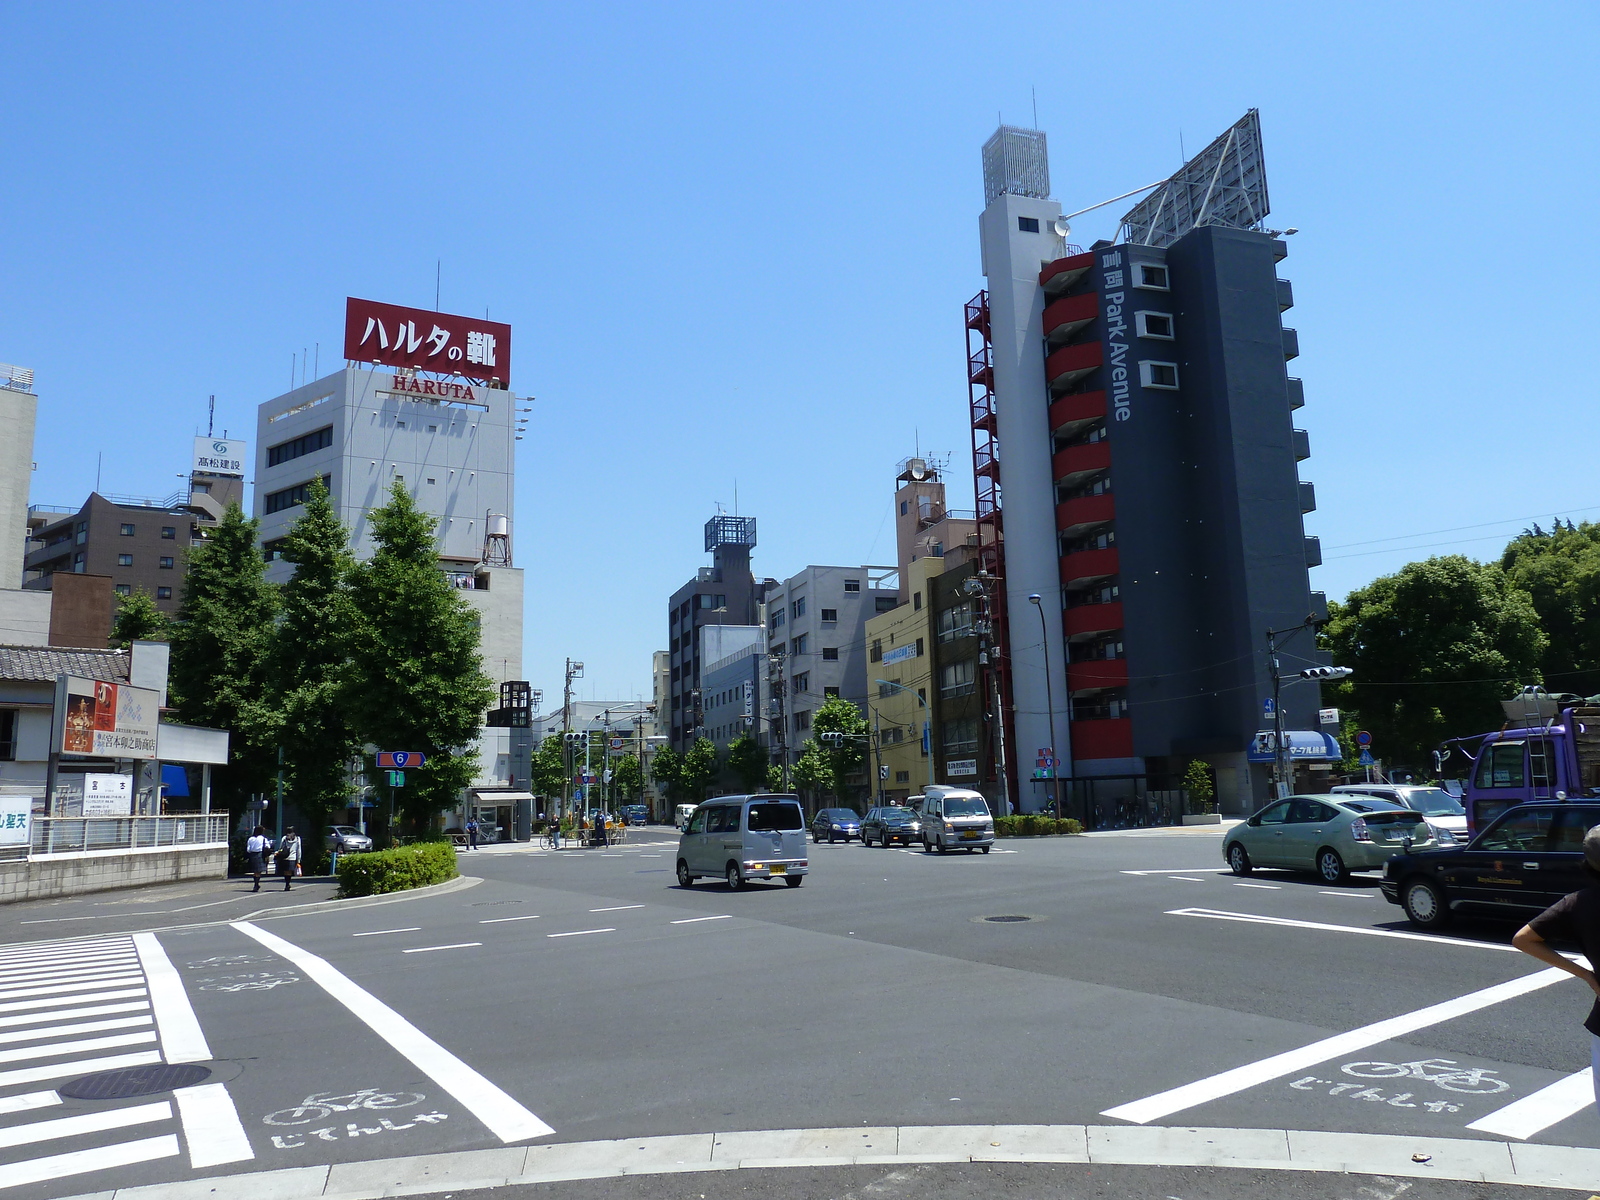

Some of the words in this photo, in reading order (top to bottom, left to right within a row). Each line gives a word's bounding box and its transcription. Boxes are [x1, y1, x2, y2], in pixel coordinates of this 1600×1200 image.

[1101, 250, 1123, 290] 言問
[1105, 291, 1128, 341] Park
[359, 315, 497, 367] ハルタの靴
[392, 374, 476, 402] HARUTA
[1108, 342, 1132, 422] Avenue
[397, 753, 404, 763] 6
[1289, 1076, 1465, 1113] じてんしゃ
[271, 1110, 449, 1149] じてんしゃ
